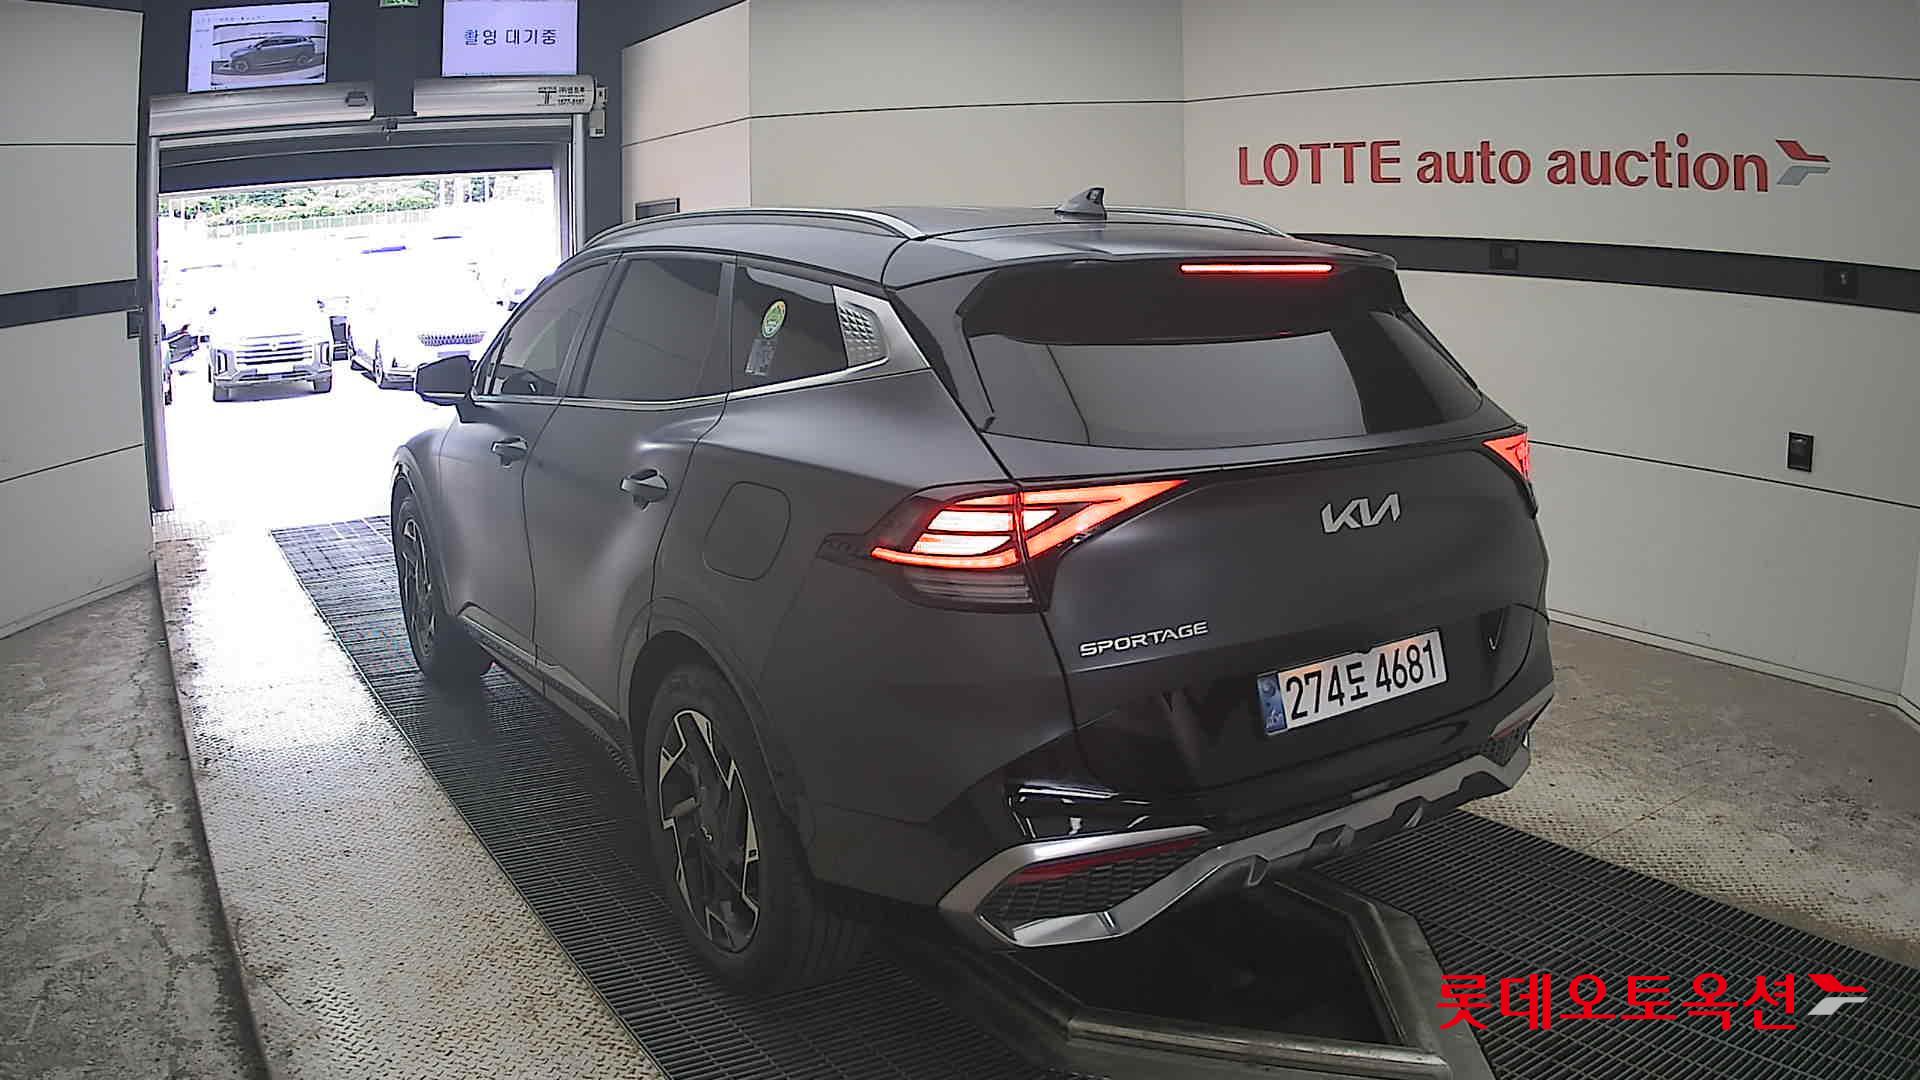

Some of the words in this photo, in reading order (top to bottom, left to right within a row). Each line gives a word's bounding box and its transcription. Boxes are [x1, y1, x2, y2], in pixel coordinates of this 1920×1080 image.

[505, 28, 557, 46] 대기중
[1239, 140, 1401, 187] LOTTE
[1417, 140, 1532, 184] auto
[1546, 133, 1769, 192] auction
[1321, 493, 1401, 533] KIA
[1080, 621, 1209, 657] SPORTAGE
[1285, 661, 1369, 720] 274도
[1375, 639, 1437, 692] 4681
